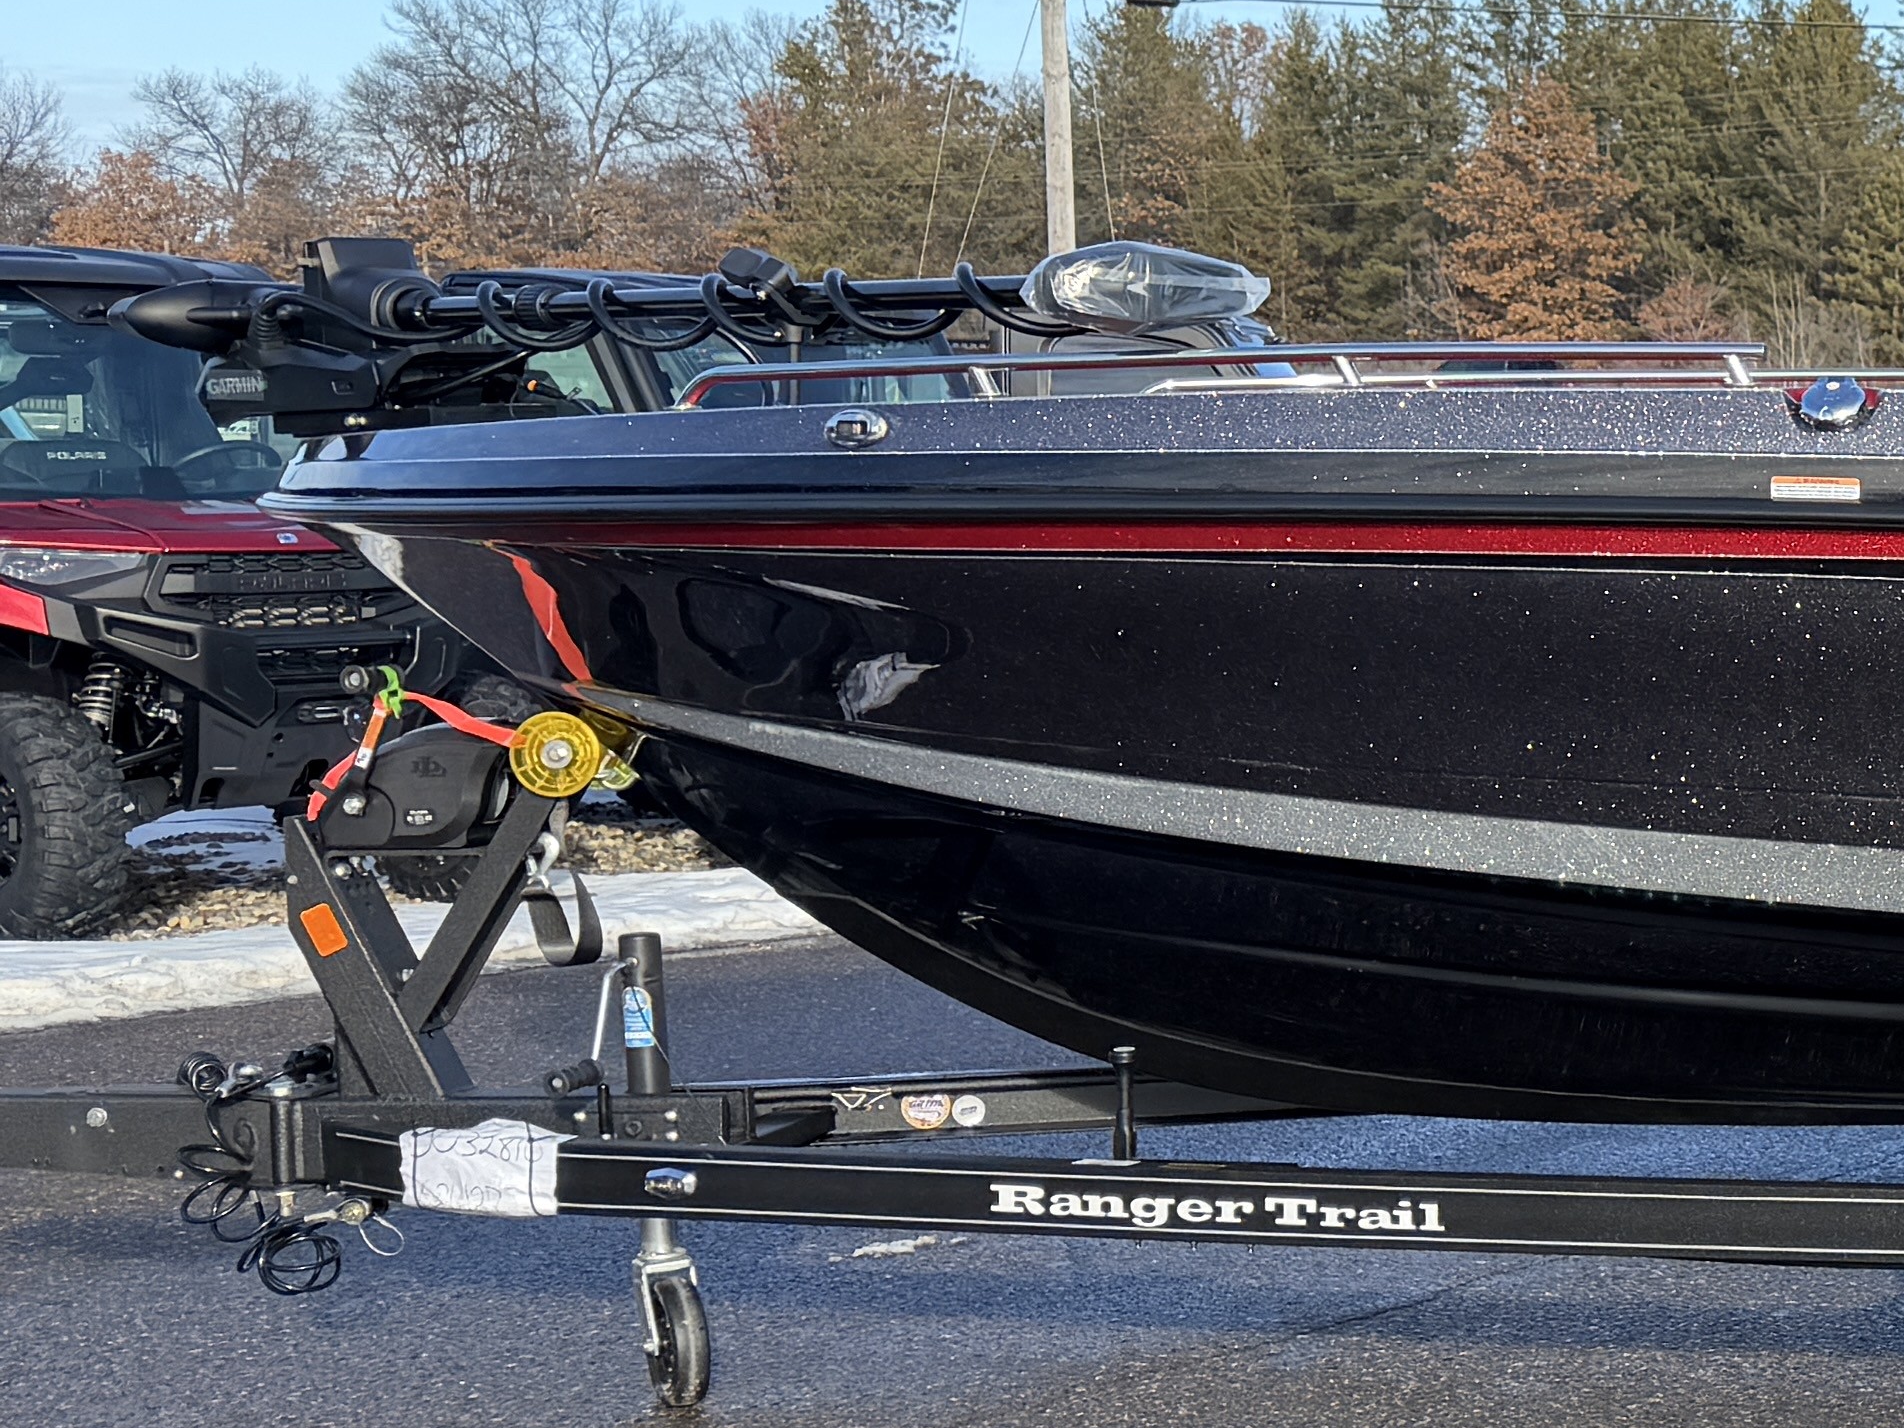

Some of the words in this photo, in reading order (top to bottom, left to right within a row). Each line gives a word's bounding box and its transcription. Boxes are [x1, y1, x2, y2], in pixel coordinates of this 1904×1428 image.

[207, 375, 263, 395] GARMIN
[988, 1183, 1255, 1228] Ranger
[1263, 1195, 1446, 1232] Trail
